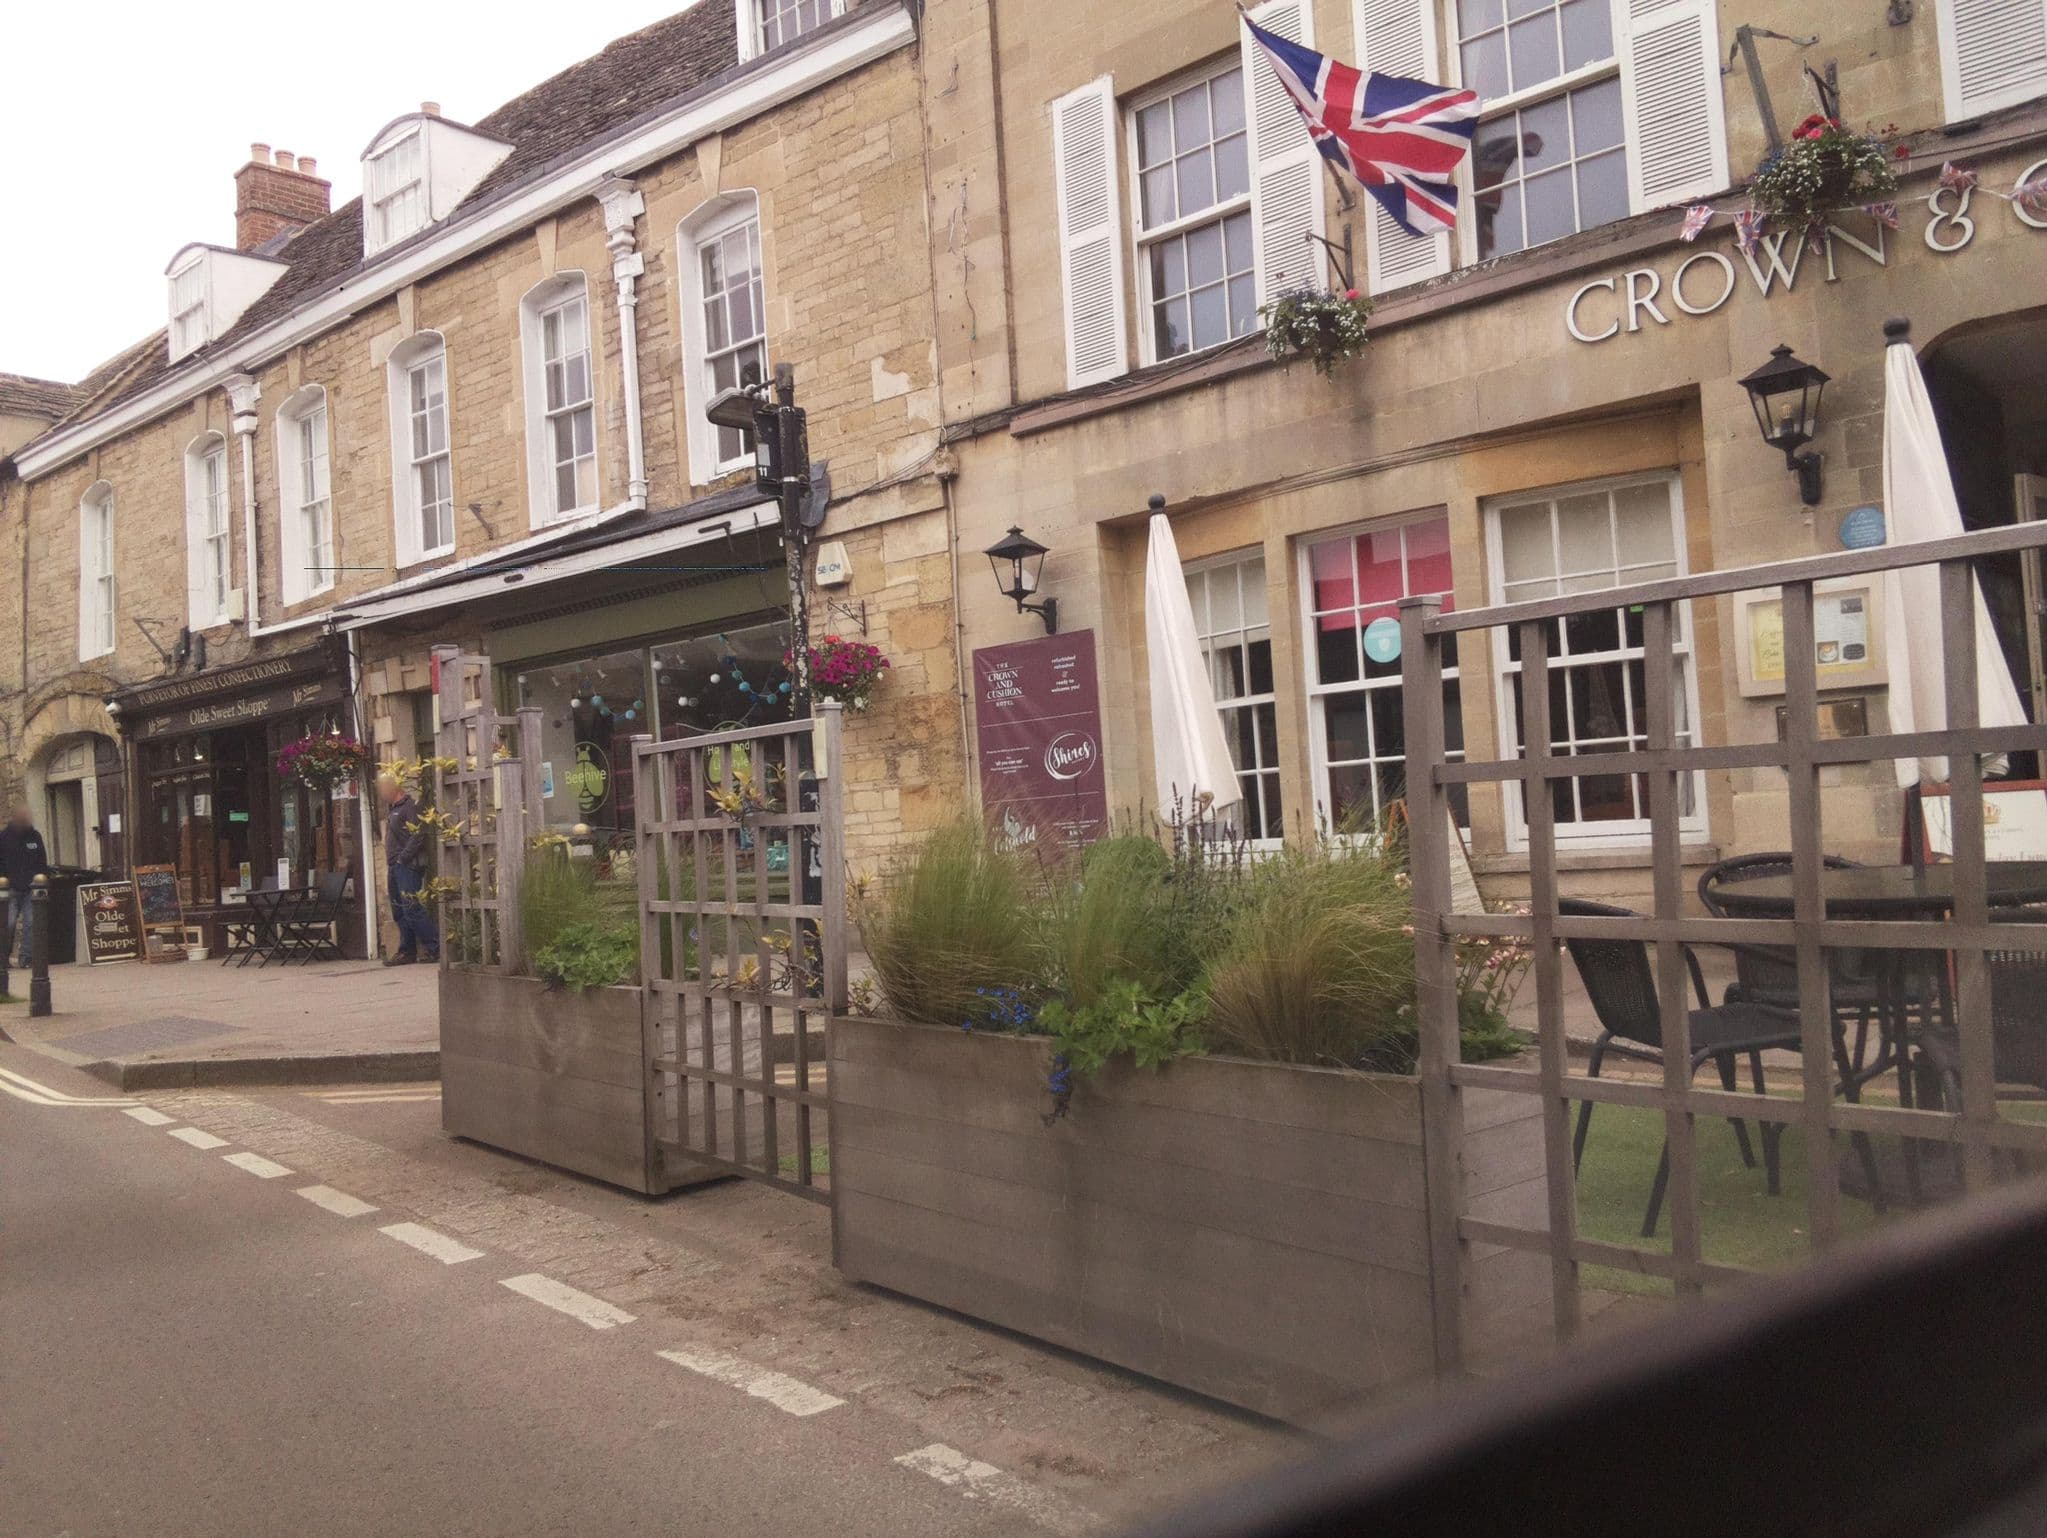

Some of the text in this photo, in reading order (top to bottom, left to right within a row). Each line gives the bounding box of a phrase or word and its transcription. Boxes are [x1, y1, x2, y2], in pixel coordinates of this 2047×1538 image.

[1565, 214, 1887, 343] CROWN
[1924, 184, 1978, 253] &
[758, 466, 768, 477] 11
[137, 658, 293, 705] PURVEYOR OF FINEST CONFECTIONERY
[988, 670, 1018, 682] CROWN
[996, 679, 1013, 690] AND
[987, 687, 1023, 700] CUSHION
[189, 708, 210, 726] Olde
[210, 704, 236, 720] Sweet
[565, 768, 607, 785] Beehive
[81, 884, 132, 905] Mr Simms
[95, 911, 125, 922] Olde
[93, 924, 129, 935] Set
